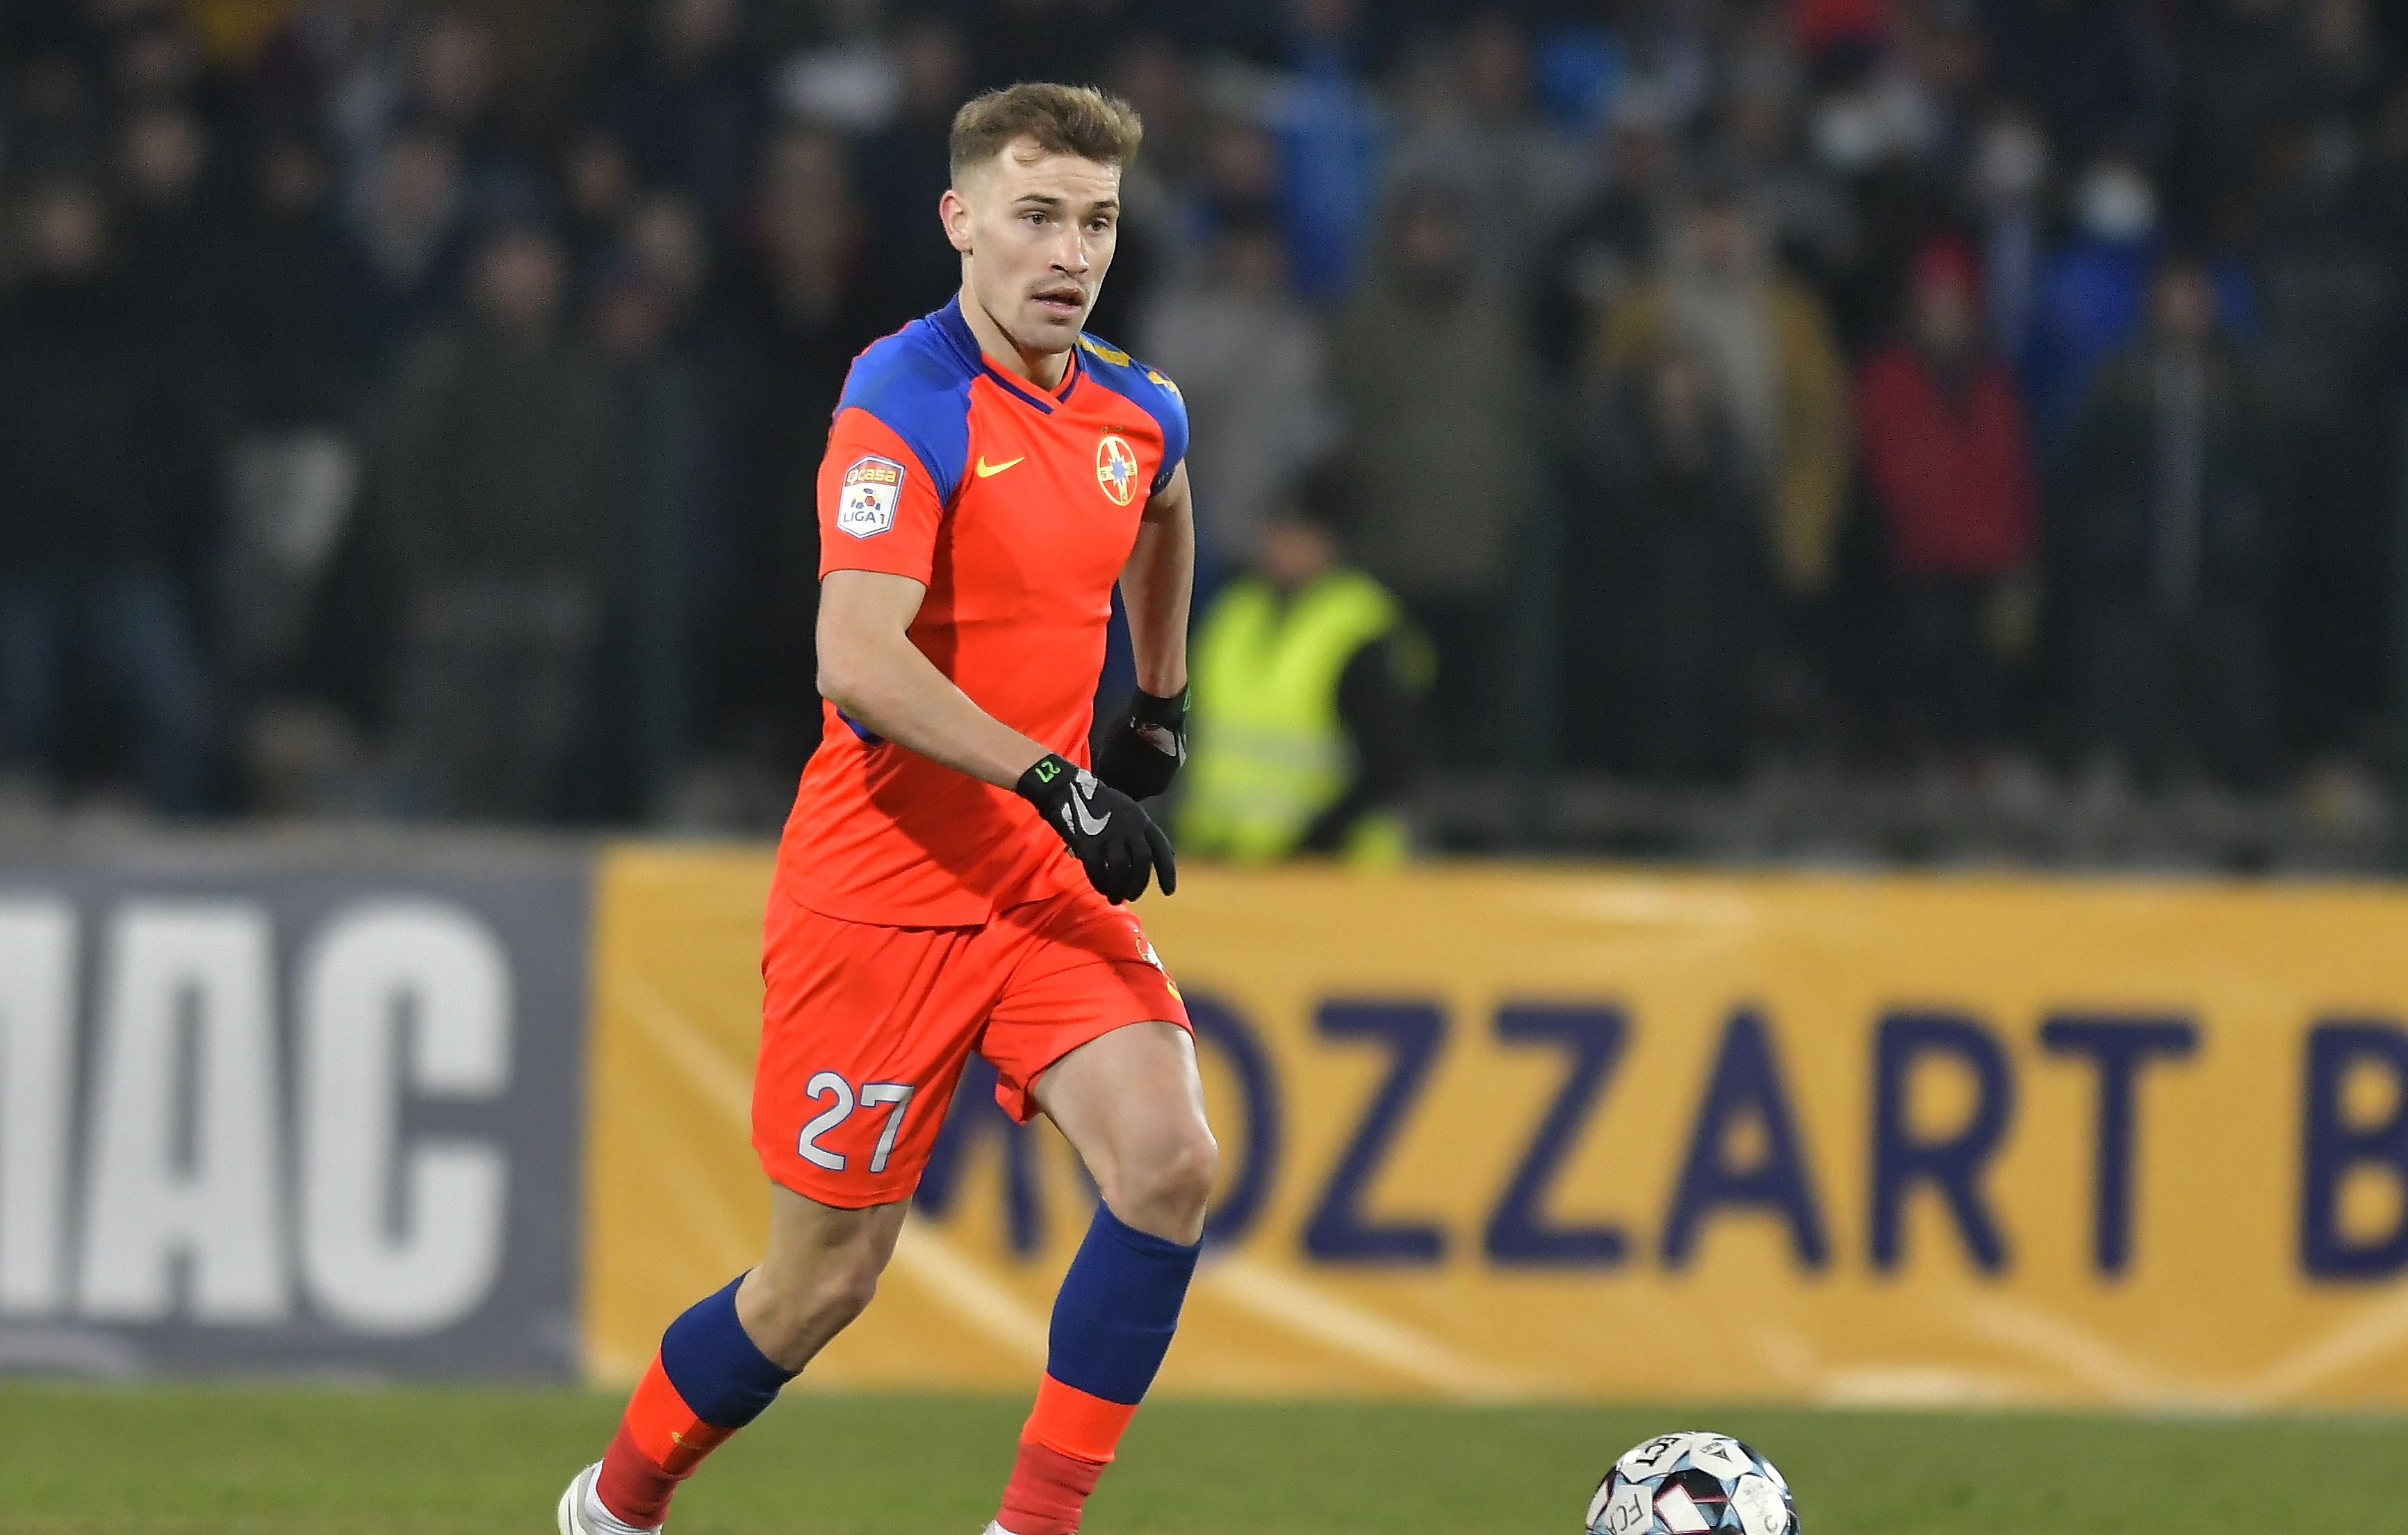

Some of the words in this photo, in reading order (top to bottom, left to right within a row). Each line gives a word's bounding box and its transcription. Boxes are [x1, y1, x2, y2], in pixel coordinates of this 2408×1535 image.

[843, 511, 876, 523] LIGA
[880, 514, 885, 525] 1
[1034, 761, 1062, 784] 27
[0, 895, 516, 1333] AC
[798, 1070, 916, 1174] 27
